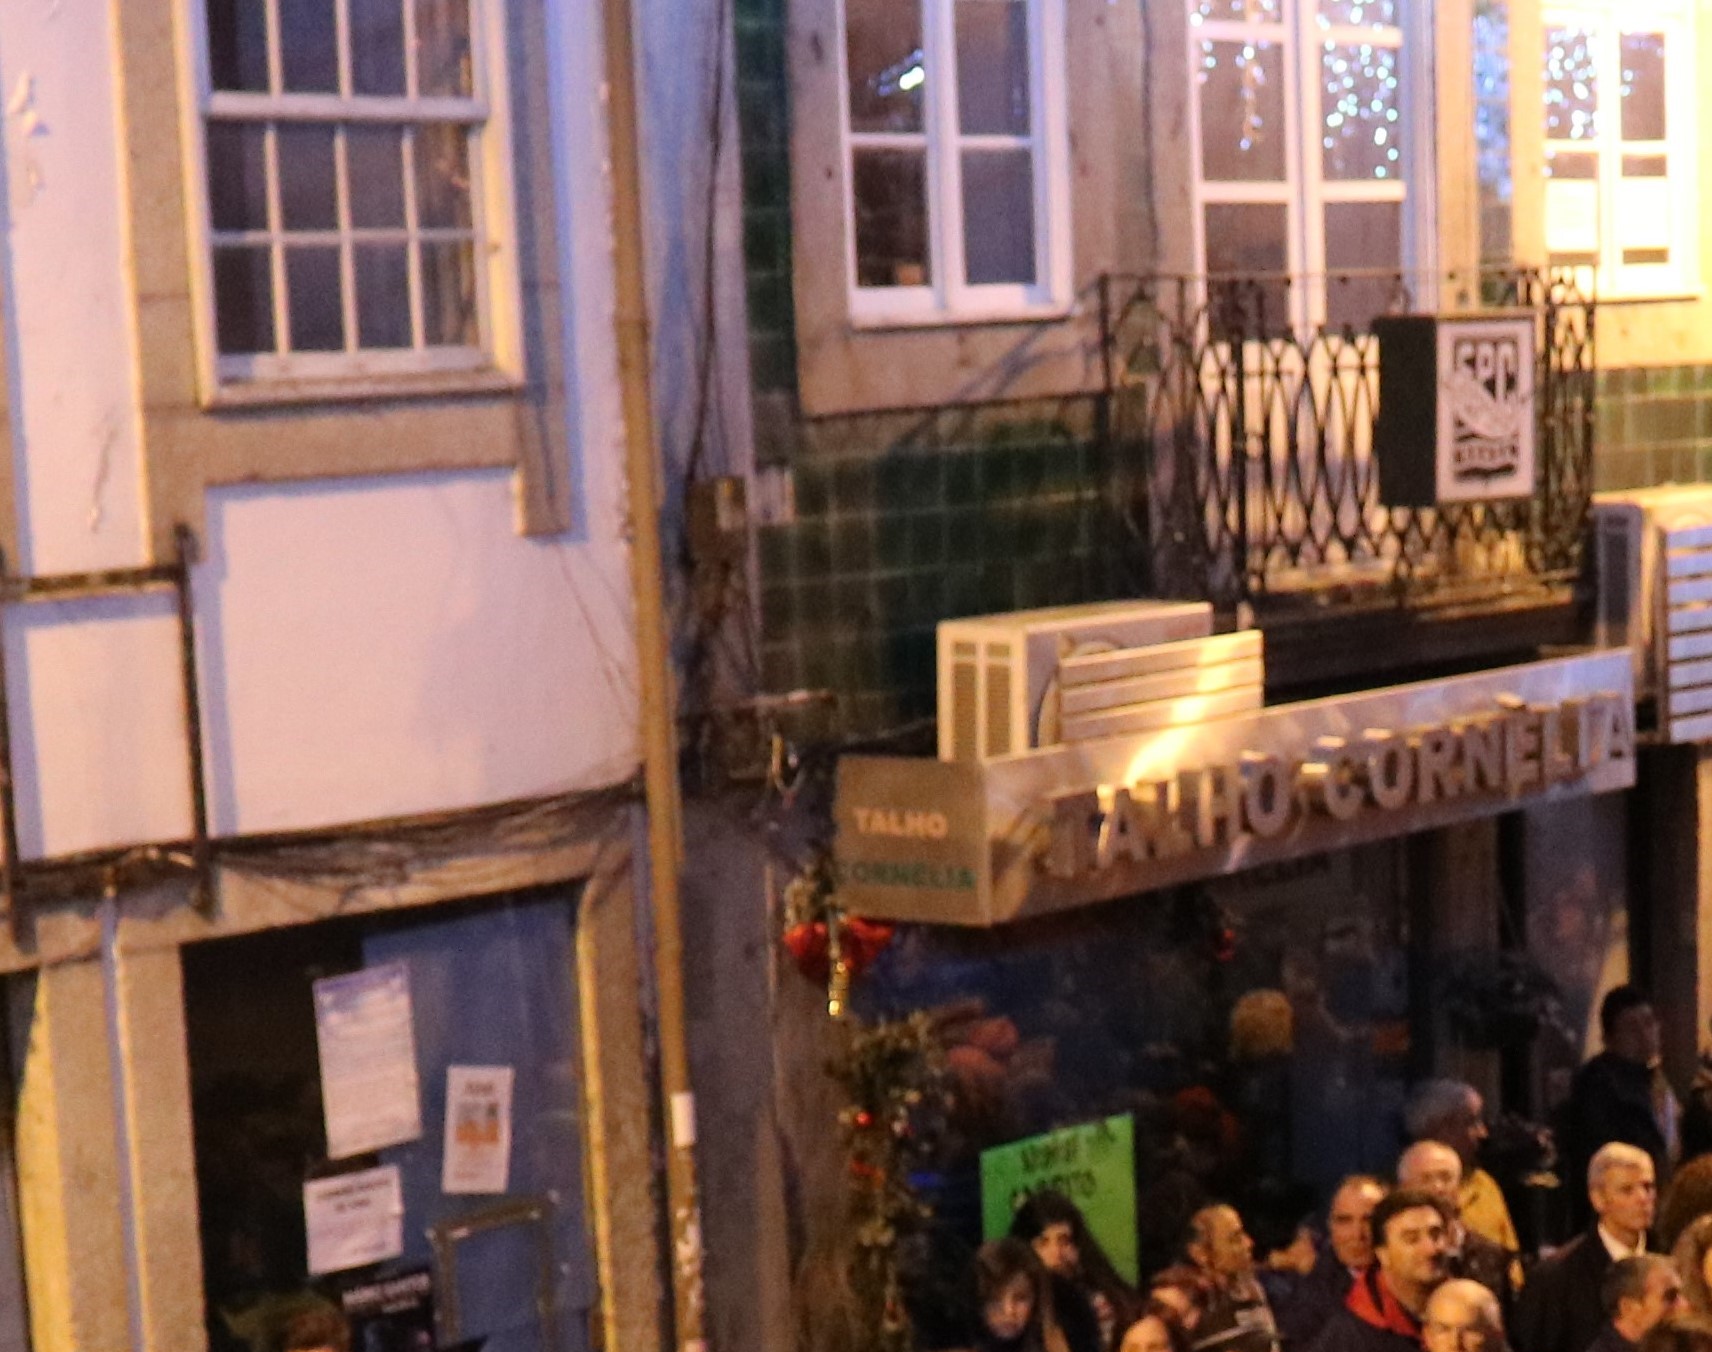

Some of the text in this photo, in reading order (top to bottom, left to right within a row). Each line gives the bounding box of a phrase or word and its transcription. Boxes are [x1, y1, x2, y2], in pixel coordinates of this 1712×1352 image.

[853, 808, 949, 839] TALHO
[1046, 694, 1632, 877] TALHO CORNELIA
